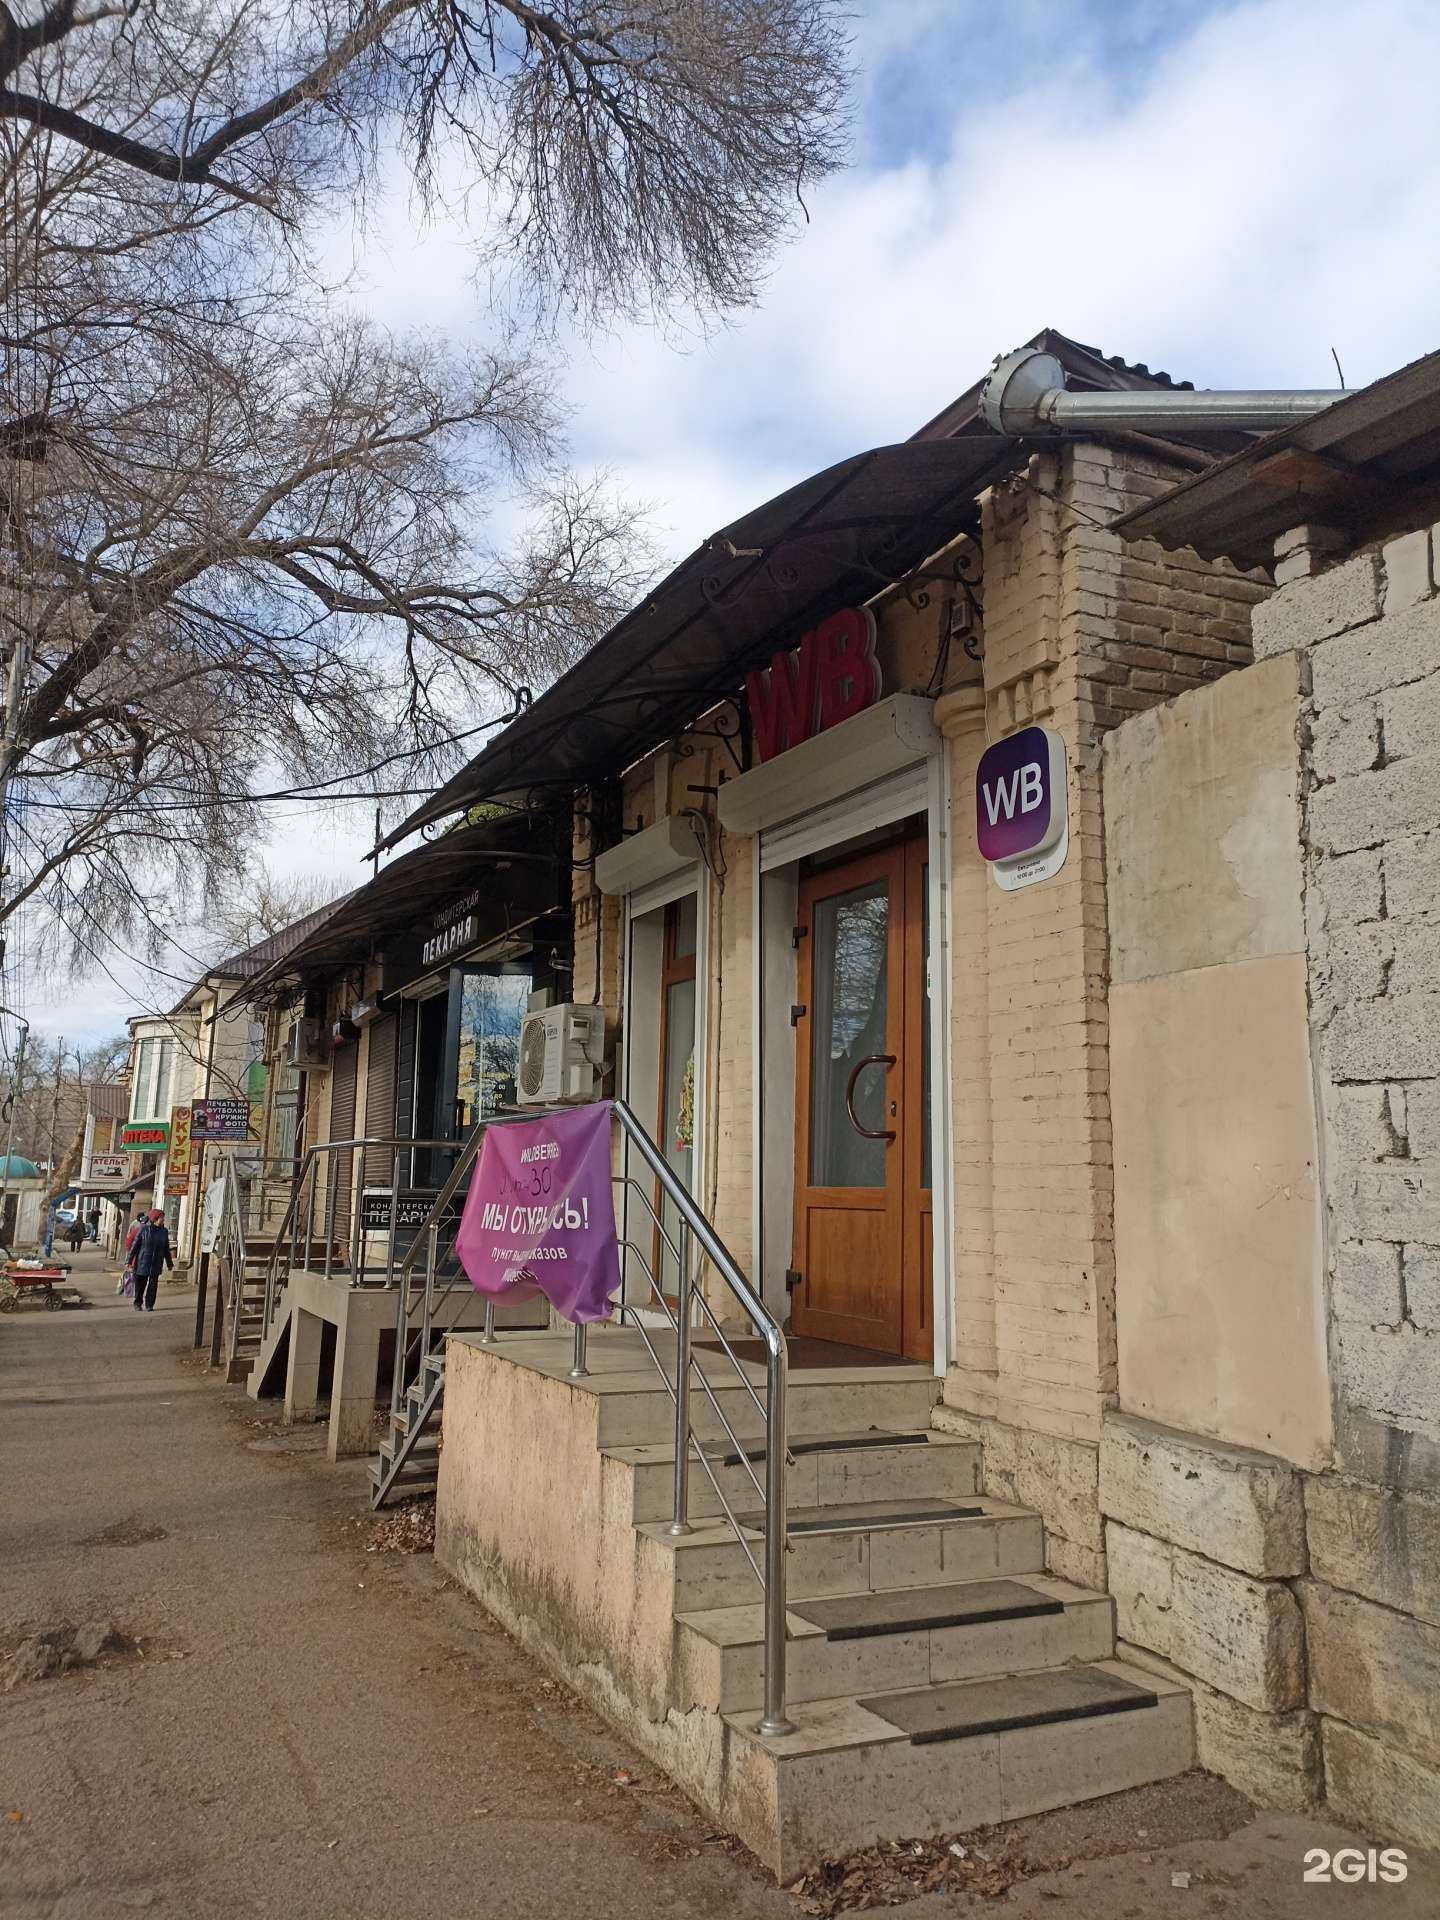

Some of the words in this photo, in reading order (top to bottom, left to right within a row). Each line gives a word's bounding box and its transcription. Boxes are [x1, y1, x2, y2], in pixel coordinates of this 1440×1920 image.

[745, 606, 883, 763] WB
[982, 761, 1044, 827] WB
[422, 915, 472, 965] ПЕКАРНЯ
[92, 1158, 127, 1166] АТЕЛЬЕ
[369, 1210, 432, 1223] ПЕАРН
[481, 1202, 509, 1232] МЫ
